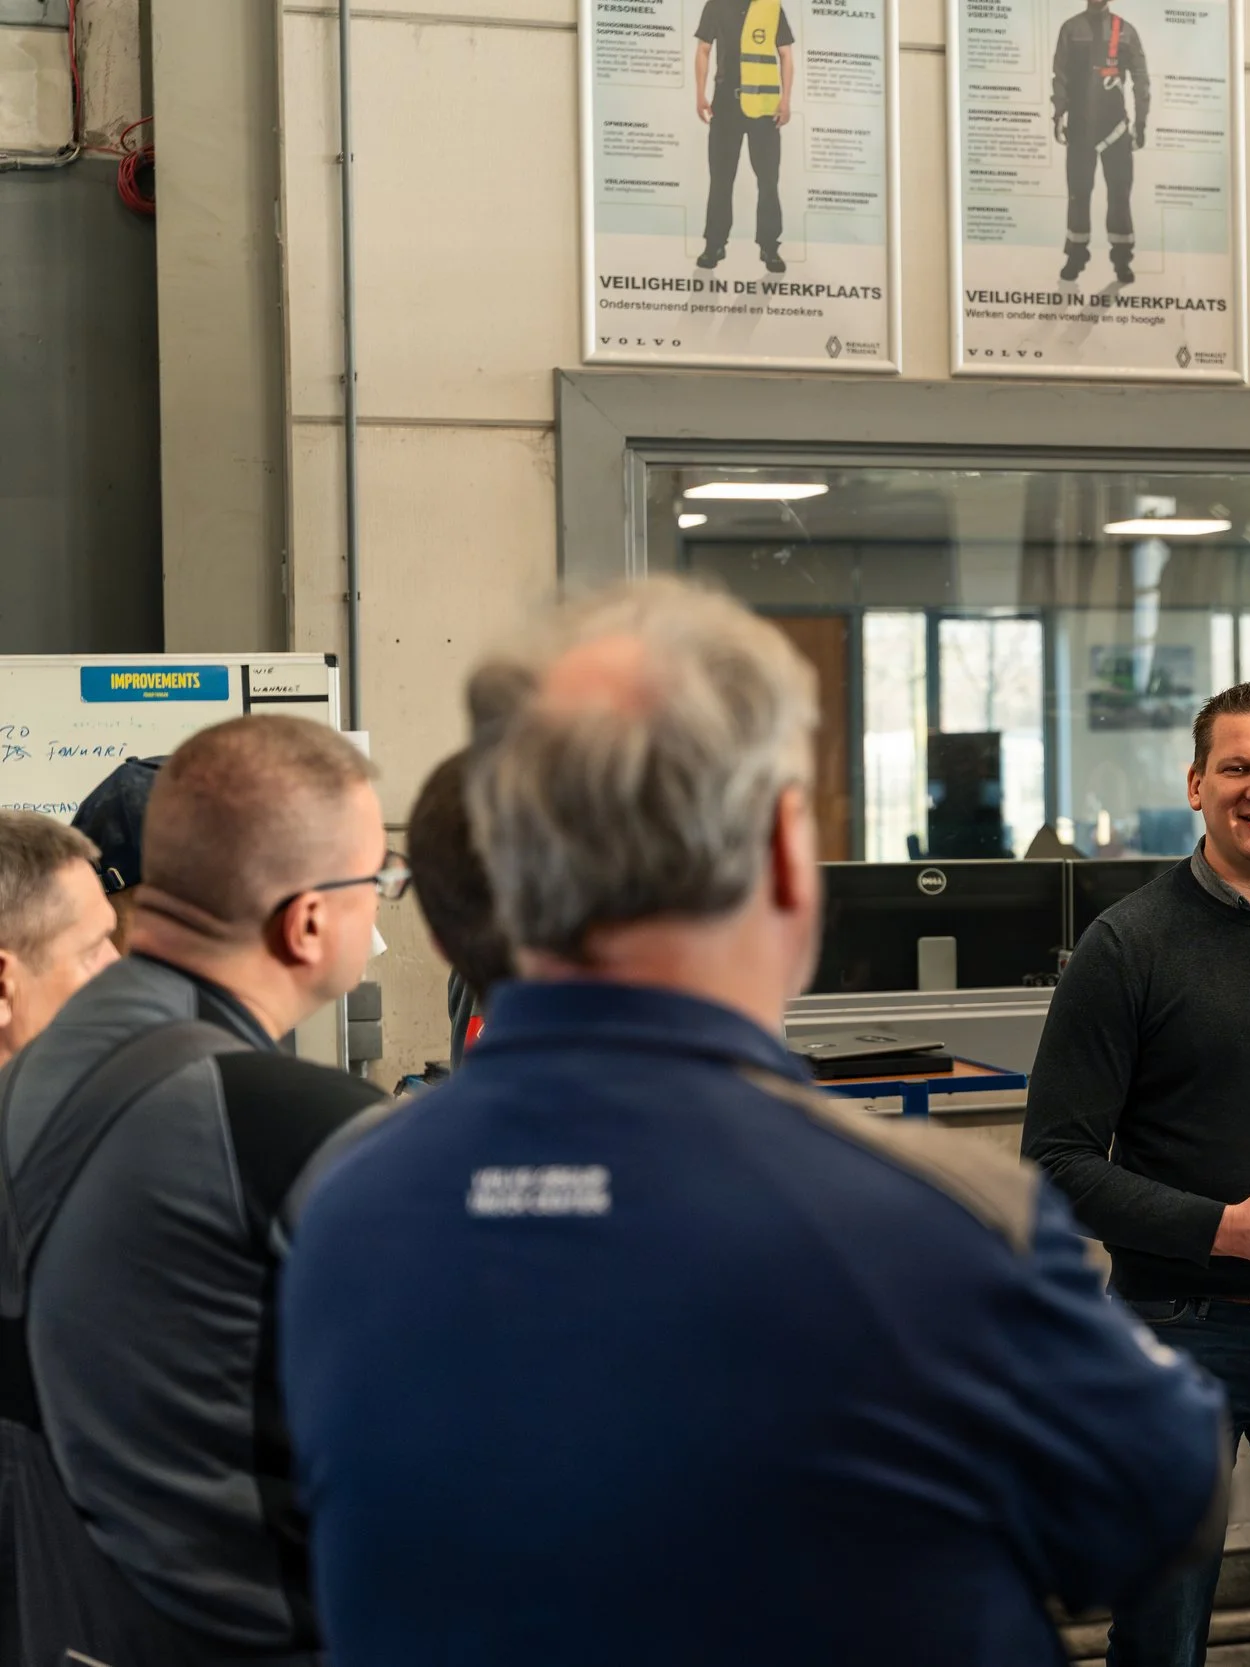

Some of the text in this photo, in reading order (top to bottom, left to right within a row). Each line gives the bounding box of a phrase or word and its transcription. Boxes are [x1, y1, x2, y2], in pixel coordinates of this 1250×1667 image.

[597, 4, 656, 14] PERSONEEL
[812, 8, 876, 19] WERKPLAATS
[600, 275, 882, 300] VEILIGHEID IN DE WERKPLAATS
[599, 298, 824, 317] Ondersteunend personeel en bezoekers
[966, 290, 1227, 312] VEILIGHEID IN DE WERKPLAATS
[965, 308, 1166, 327] Werken onder een voertuig en op hoogte
[600, 336, 681, 347] VOLVO
[968, 348, 1044, 358] VOLVO
[111, 672, 201, 689] IMPROVEMENTS
